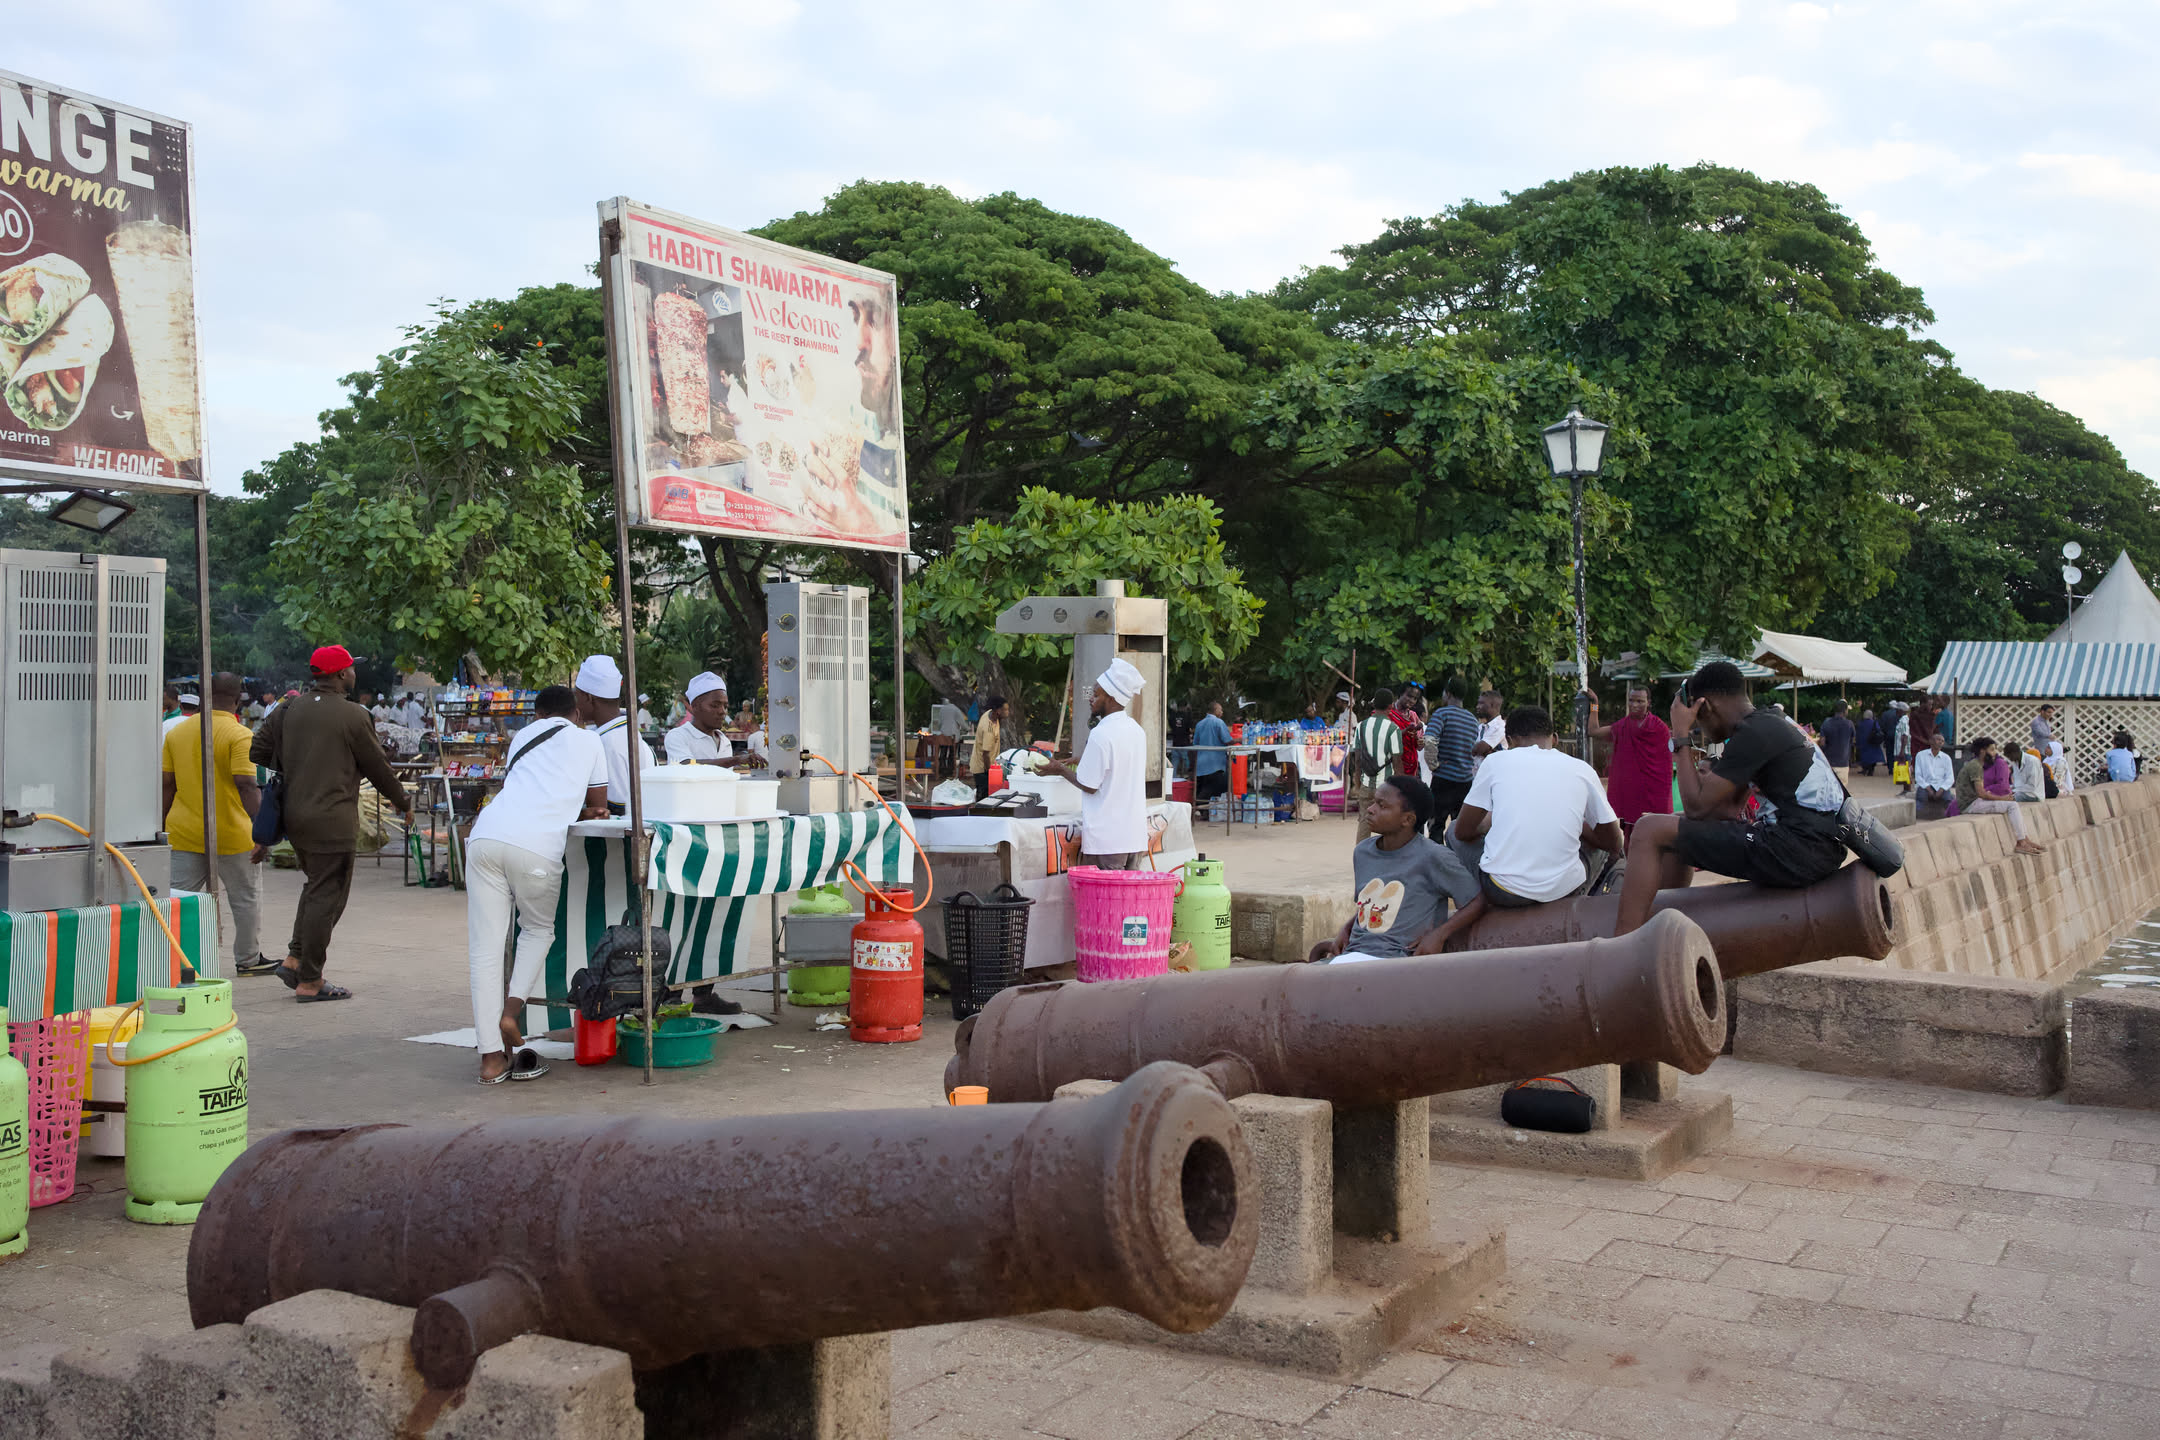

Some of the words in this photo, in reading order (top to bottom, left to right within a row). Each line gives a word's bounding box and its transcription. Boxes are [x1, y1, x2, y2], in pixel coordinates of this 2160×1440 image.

[0, 81, 155, 190] NGE
[648, 231, 724, 278] HABITI
[730, 255, 843, 310] SHAWARMA
[746, 289, 842, 340] Welcome
[753, 326, 770, 339] THE
[771, 330, 791, 345] BEST
[793, 336, 839, 354] SHAWARMA
[74, 445, 165, 478] WELCOME
[199, 1087, 244, 1110] TAIFA
[0, 1124, 22, 1146] AS
